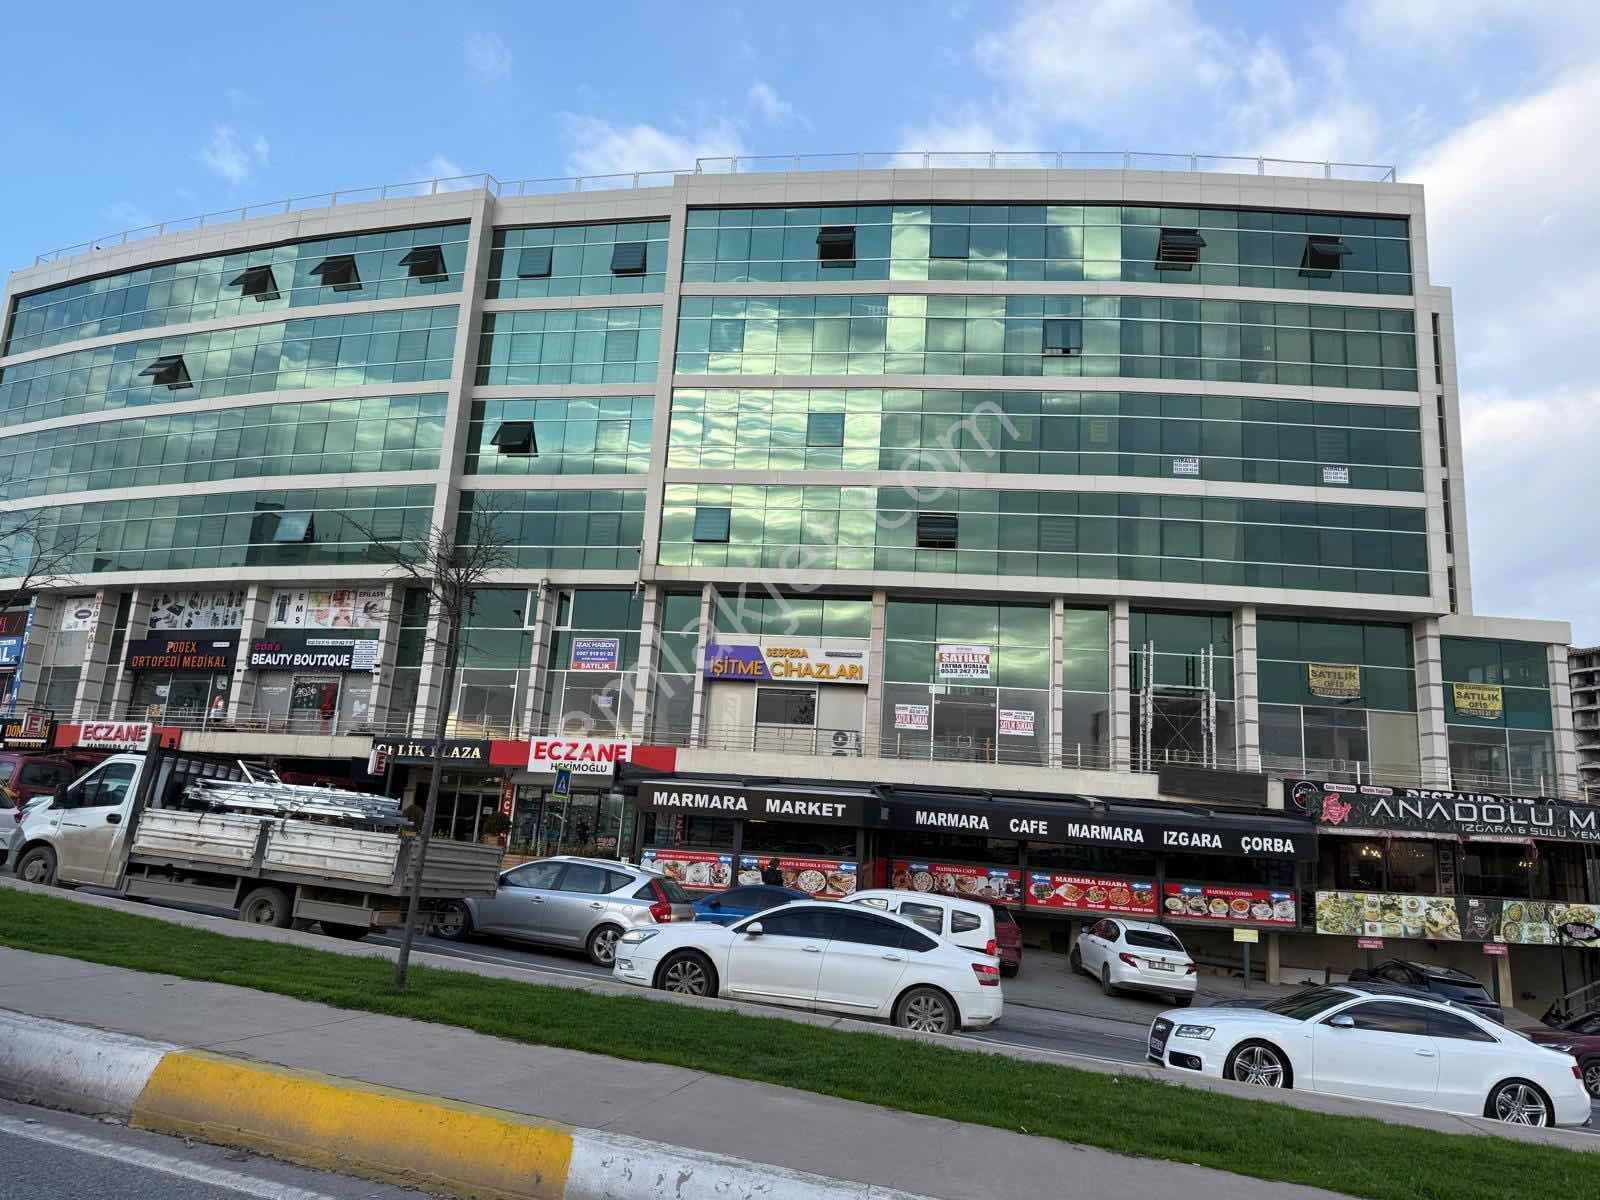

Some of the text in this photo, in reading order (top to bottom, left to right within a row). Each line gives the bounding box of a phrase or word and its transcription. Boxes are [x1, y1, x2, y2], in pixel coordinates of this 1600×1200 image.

[166, 641, 197, 654] PODEX
[132, 653, 226, 668] ORTOPEDİ MEDİKAL
[251, 653, 292, 666] BEAUTY
[293, 653, 350, 667] BOUTIQUE
[944, 653, 987, 663] SATILIK
[710, 655, 864, 680] İŞİTME CİHAZLARI
[1311, 669, 1357, 680] SATILIK
[1456, 691, 1499, 702] SATILIK
[82, 723, 147, 742] ECZANE
[534, 741, 628, 763] ECZANE
[550, 761, 608, 773] HEKİMOĞLU
[653, 791, 847, 818] MARMARA MARKET
[1371, 799, 1554, 827] ANADOLU
[915, 810, 1295, 855] MARMARA CAFE MARMARA IZGARA ÇORBA
[1462, 823, 1514, 835] IZGARA
[1519, 825, 1526, 835] &
[1055, 876, 1127, 888] MARMARA IZGARA
